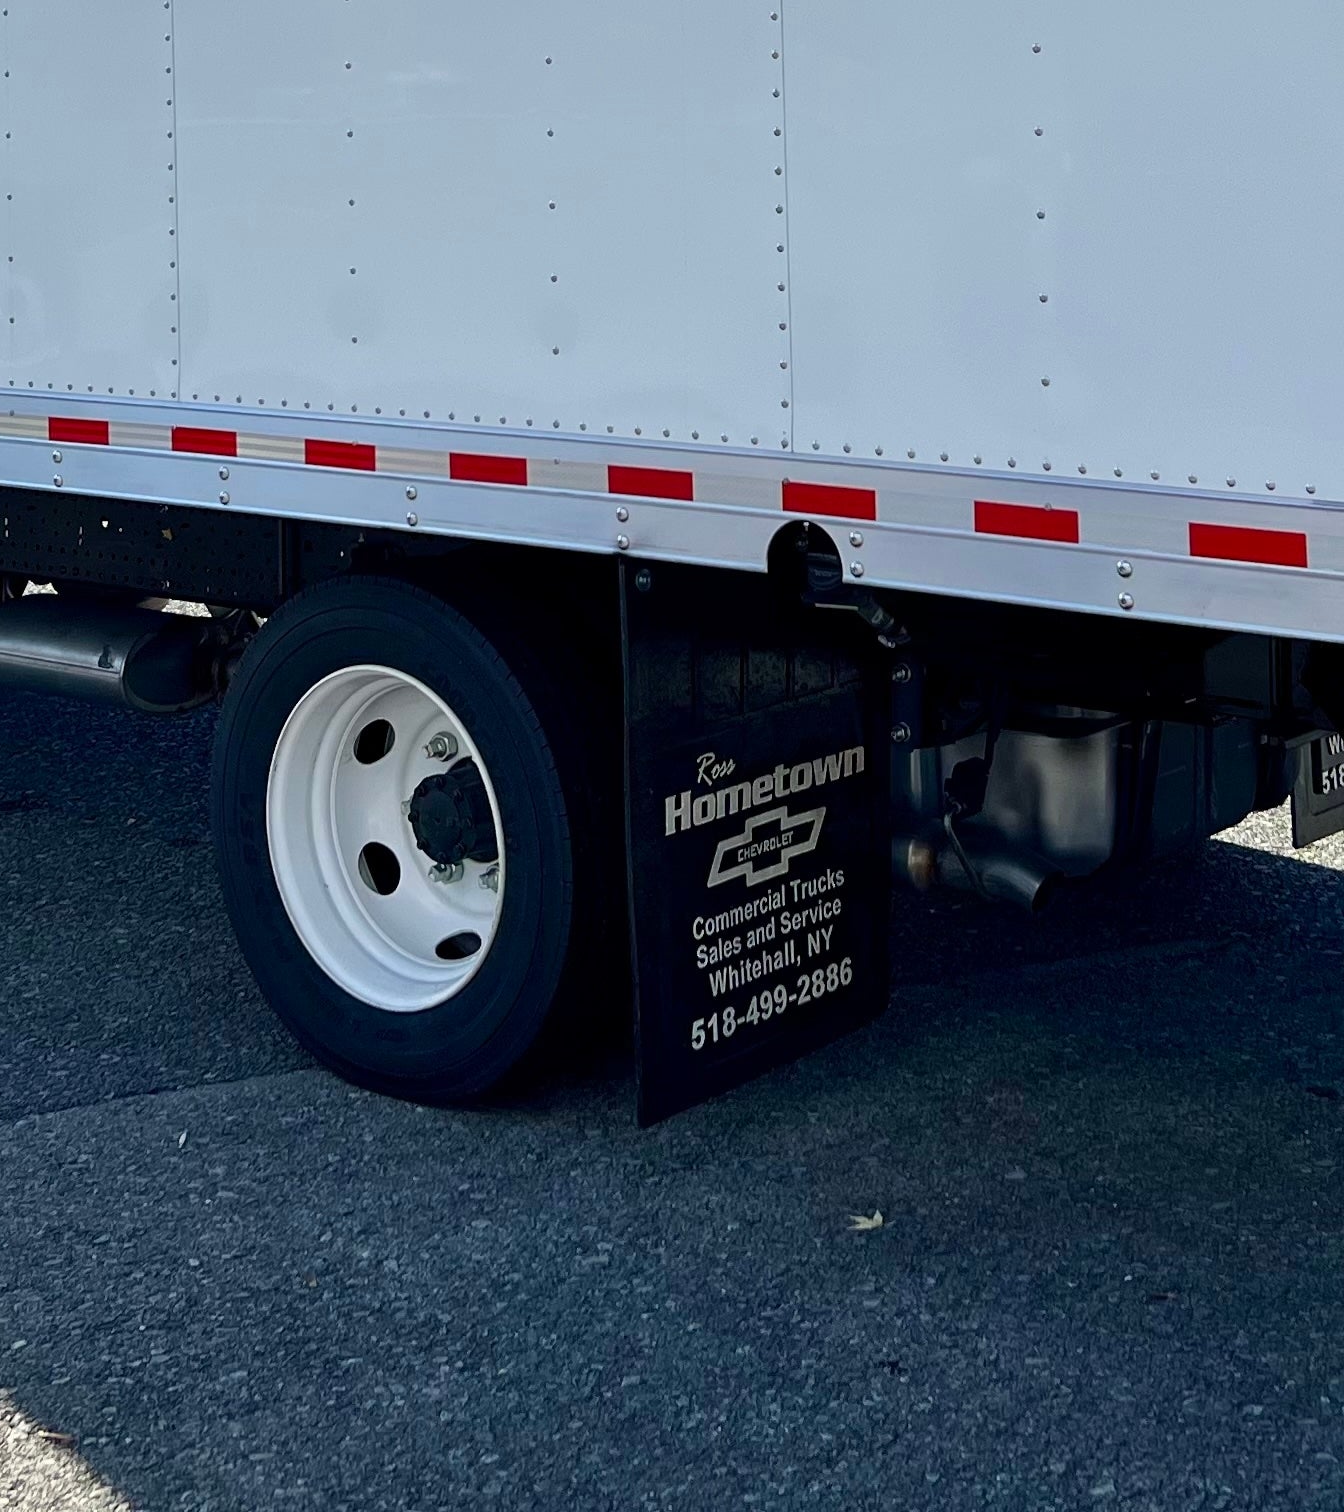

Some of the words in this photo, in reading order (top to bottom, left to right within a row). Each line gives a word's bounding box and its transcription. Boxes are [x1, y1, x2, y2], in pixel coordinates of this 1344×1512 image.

[665, 745, 865, 836] Hometown
[696, 752, 736, 786] Ross
[737, 831, 794, 862] CHEVROLET
[692, 884, 786, 940] Commercial
[789, 868, 845, 903] Trucks
[696, 937, 742, 969] Sales
[746, 916, 776, 949] and
[780, 898, 842, 935] Service
[709, 939, 801, 998] Whitehall,
[807, 924, 834, 958] NY
[690, 956, 853, 1051] 518-499-2886
